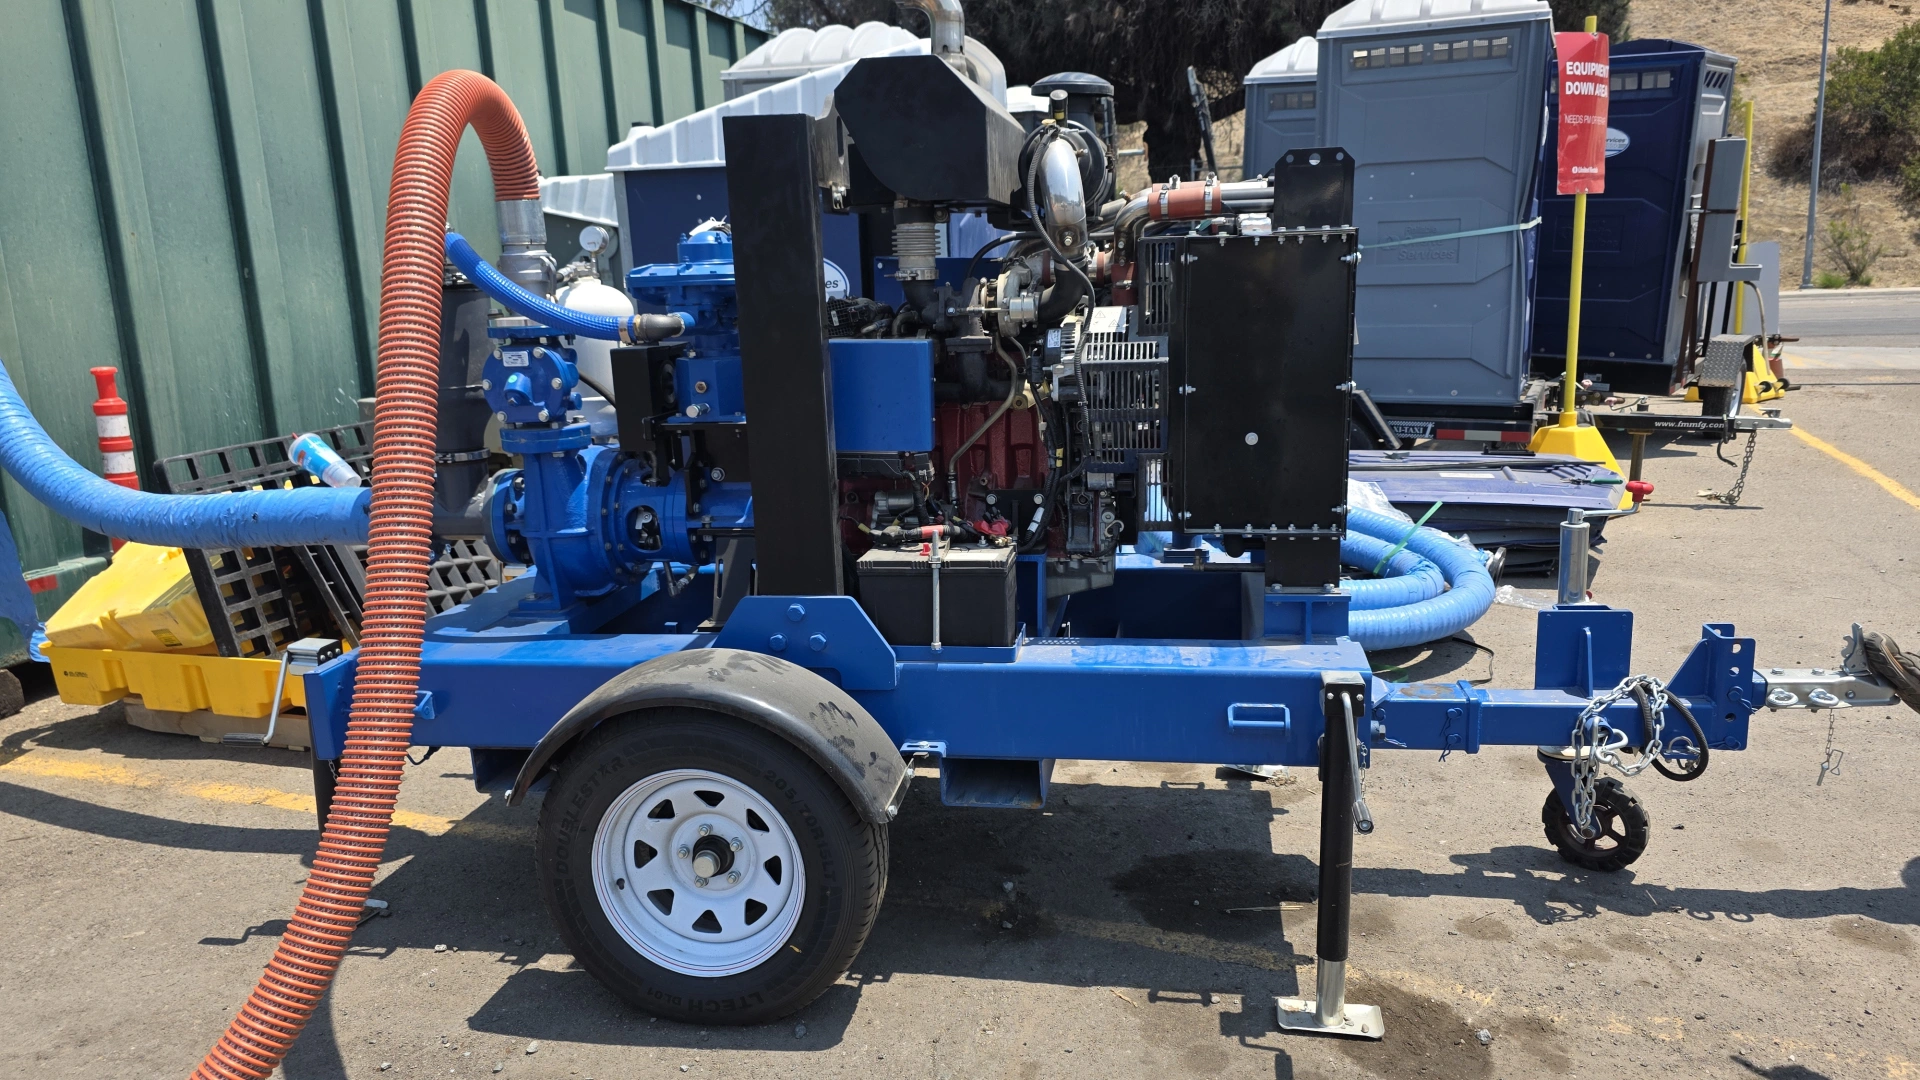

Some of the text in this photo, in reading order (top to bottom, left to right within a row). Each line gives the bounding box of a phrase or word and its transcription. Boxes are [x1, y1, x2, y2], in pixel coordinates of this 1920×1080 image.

[1566, 61, 1609, 78] EQUIPMENT
[1565, 81, 1608, 98] DOWN AREA
[1398, 248, 1455, 260] Services
[825, 280, 839, 288] es
[1393, 426, 1423, 434] XI-TAXI
[763, 770, 837, 883] 205/70R15LT
[646, 987, 765, 1013] LTECH DL01
